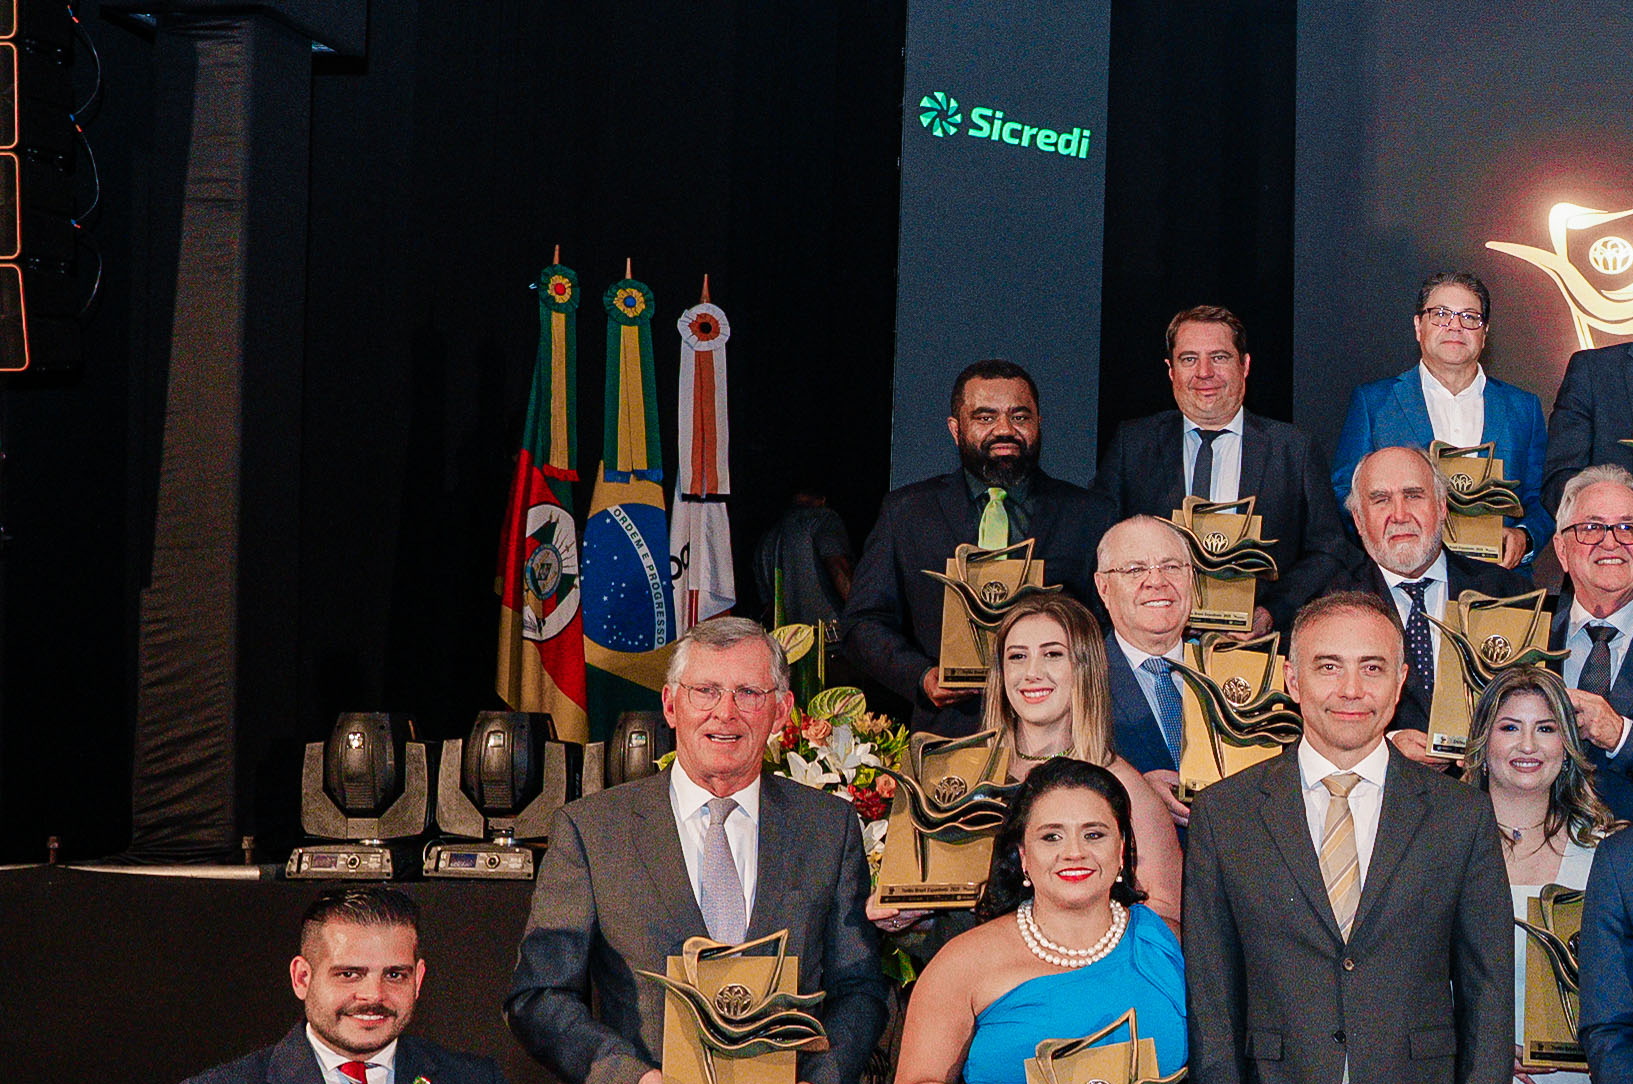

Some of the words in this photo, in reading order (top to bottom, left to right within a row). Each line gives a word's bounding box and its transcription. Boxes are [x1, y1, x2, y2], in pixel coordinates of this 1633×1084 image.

[968, 106, 1091, 159] Sicredi
[613, 508, 644, 549] ORDEM
[642, 552, 650, 560] E
[646, 564, 665, 645] PROGRESSO
